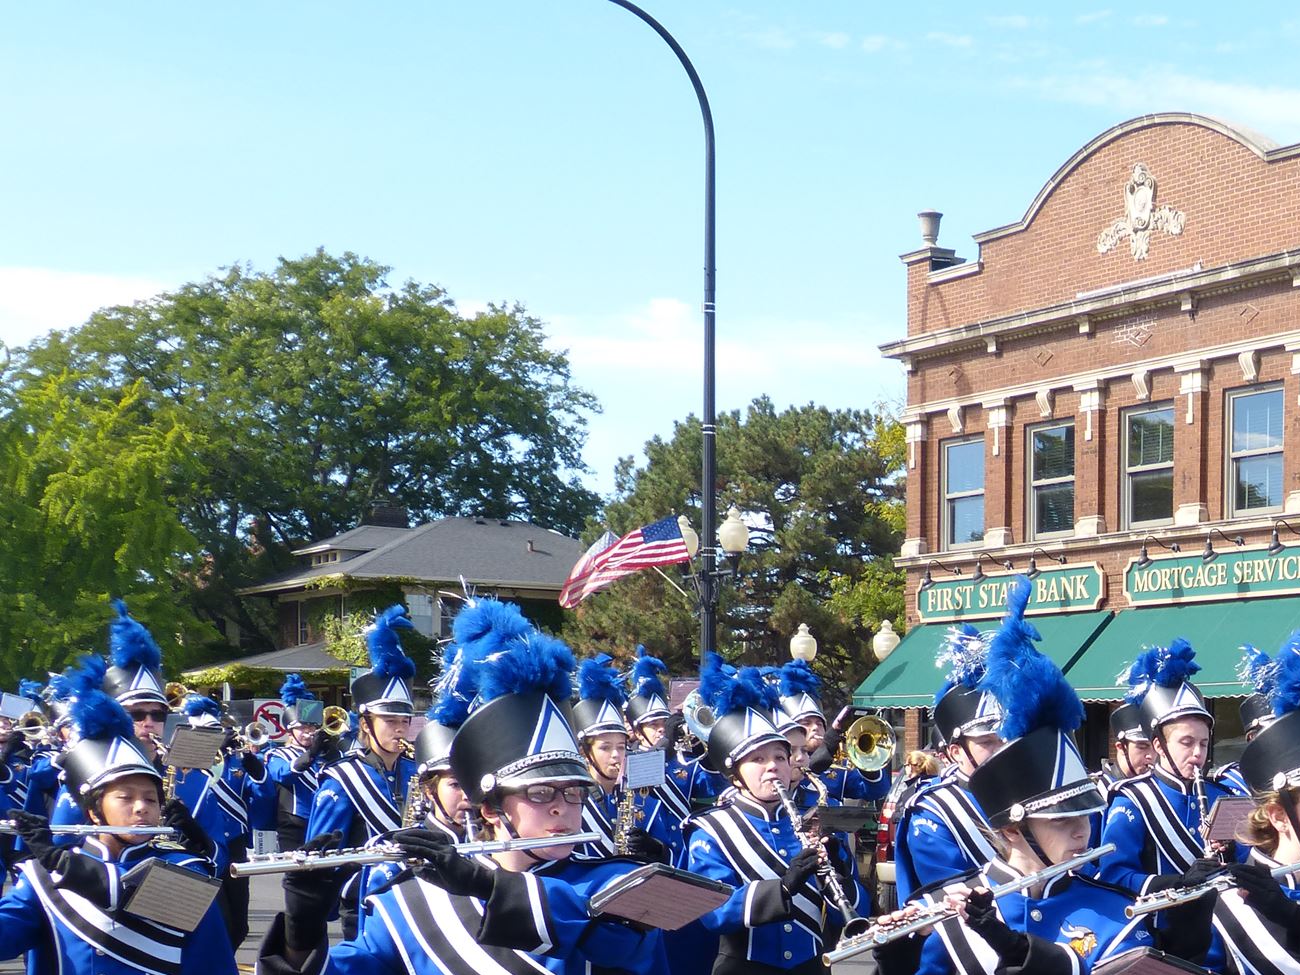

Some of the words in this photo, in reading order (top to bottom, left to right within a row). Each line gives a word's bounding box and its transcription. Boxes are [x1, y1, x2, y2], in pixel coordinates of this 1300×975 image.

[927, 585, 974, 613] FIRST
[978, 580, 1032, 610] STAT
[1036, 574, 1090, 604] BANK
[1133, 563, 1228, 593] MORTGAGE
